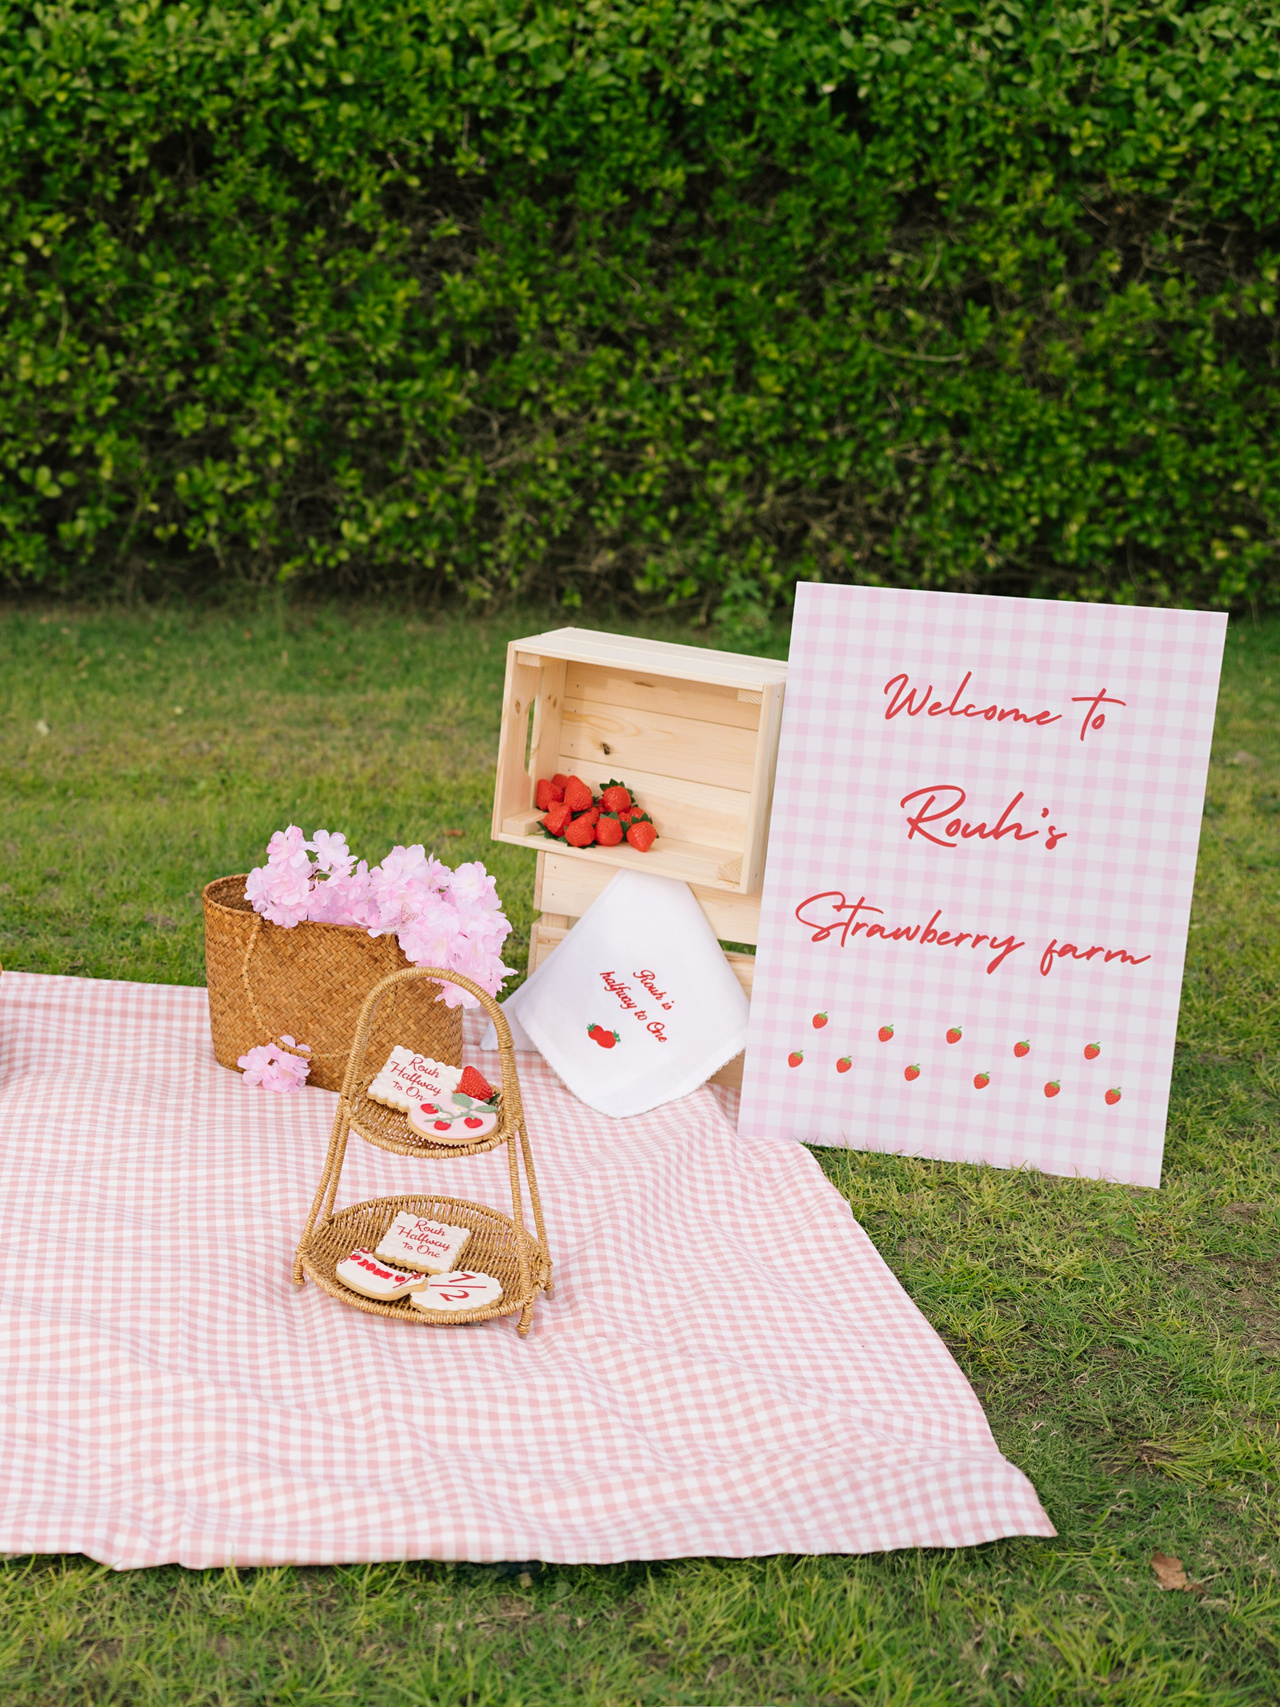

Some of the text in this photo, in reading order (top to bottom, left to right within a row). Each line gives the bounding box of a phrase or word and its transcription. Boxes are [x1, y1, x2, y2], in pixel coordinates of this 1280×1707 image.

[884, 671, 1064, 727] Welcome
[900, 784, 1068, 851] Rouh's
[795, 890, 1152, 977] Strawberry farm
[599, 970, 668, 1043] halfway to One
[632, 969, 675, 1011] Rouh is
[390, 1060, 442, 1097] Halfway
[408, 1056, 440, 1079] Rouh
[405, 1086, 427, 1101] On
[396, 1225, 451, 1252] Halfway
[414, 1219, 446, 1237] Rouh
